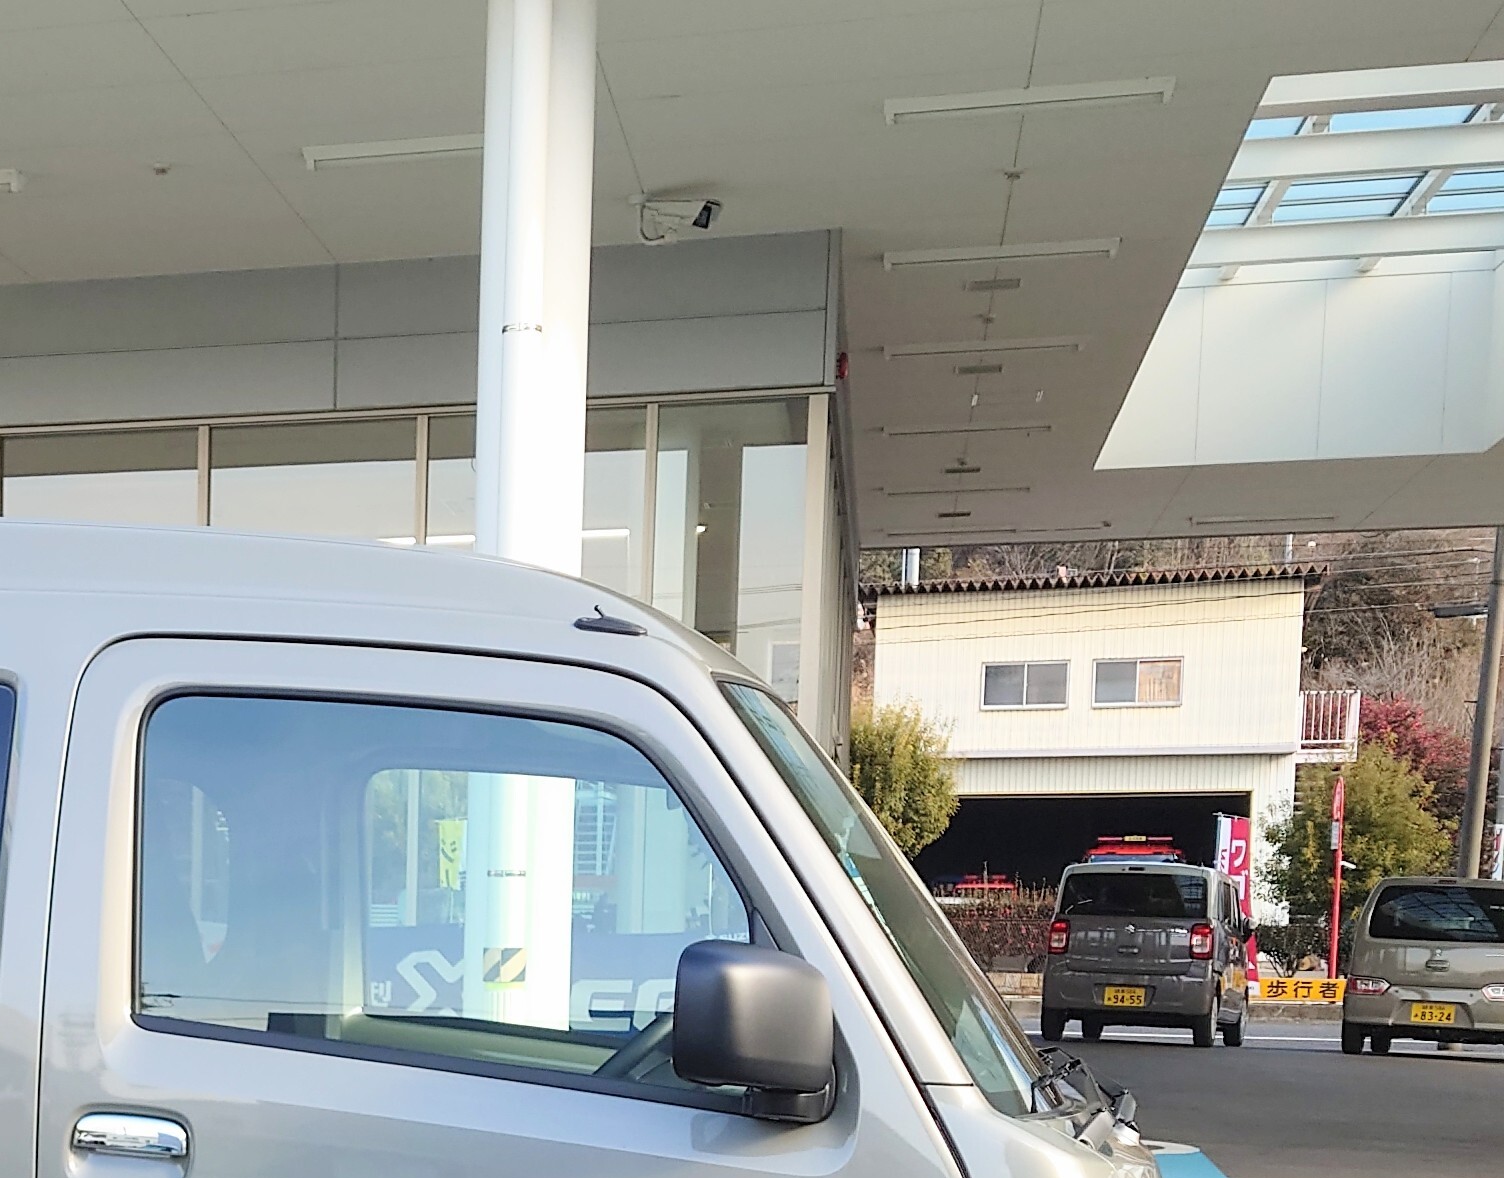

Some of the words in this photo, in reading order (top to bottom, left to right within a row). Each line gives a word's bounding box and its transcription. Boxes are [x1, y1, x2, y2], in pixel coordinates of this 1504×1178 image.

[1267, 980, 1339, 998] 歩行者
[1113, 994, 1143, 1005] 94-55
[1420, 1011, 1452, 1022] 83-24
